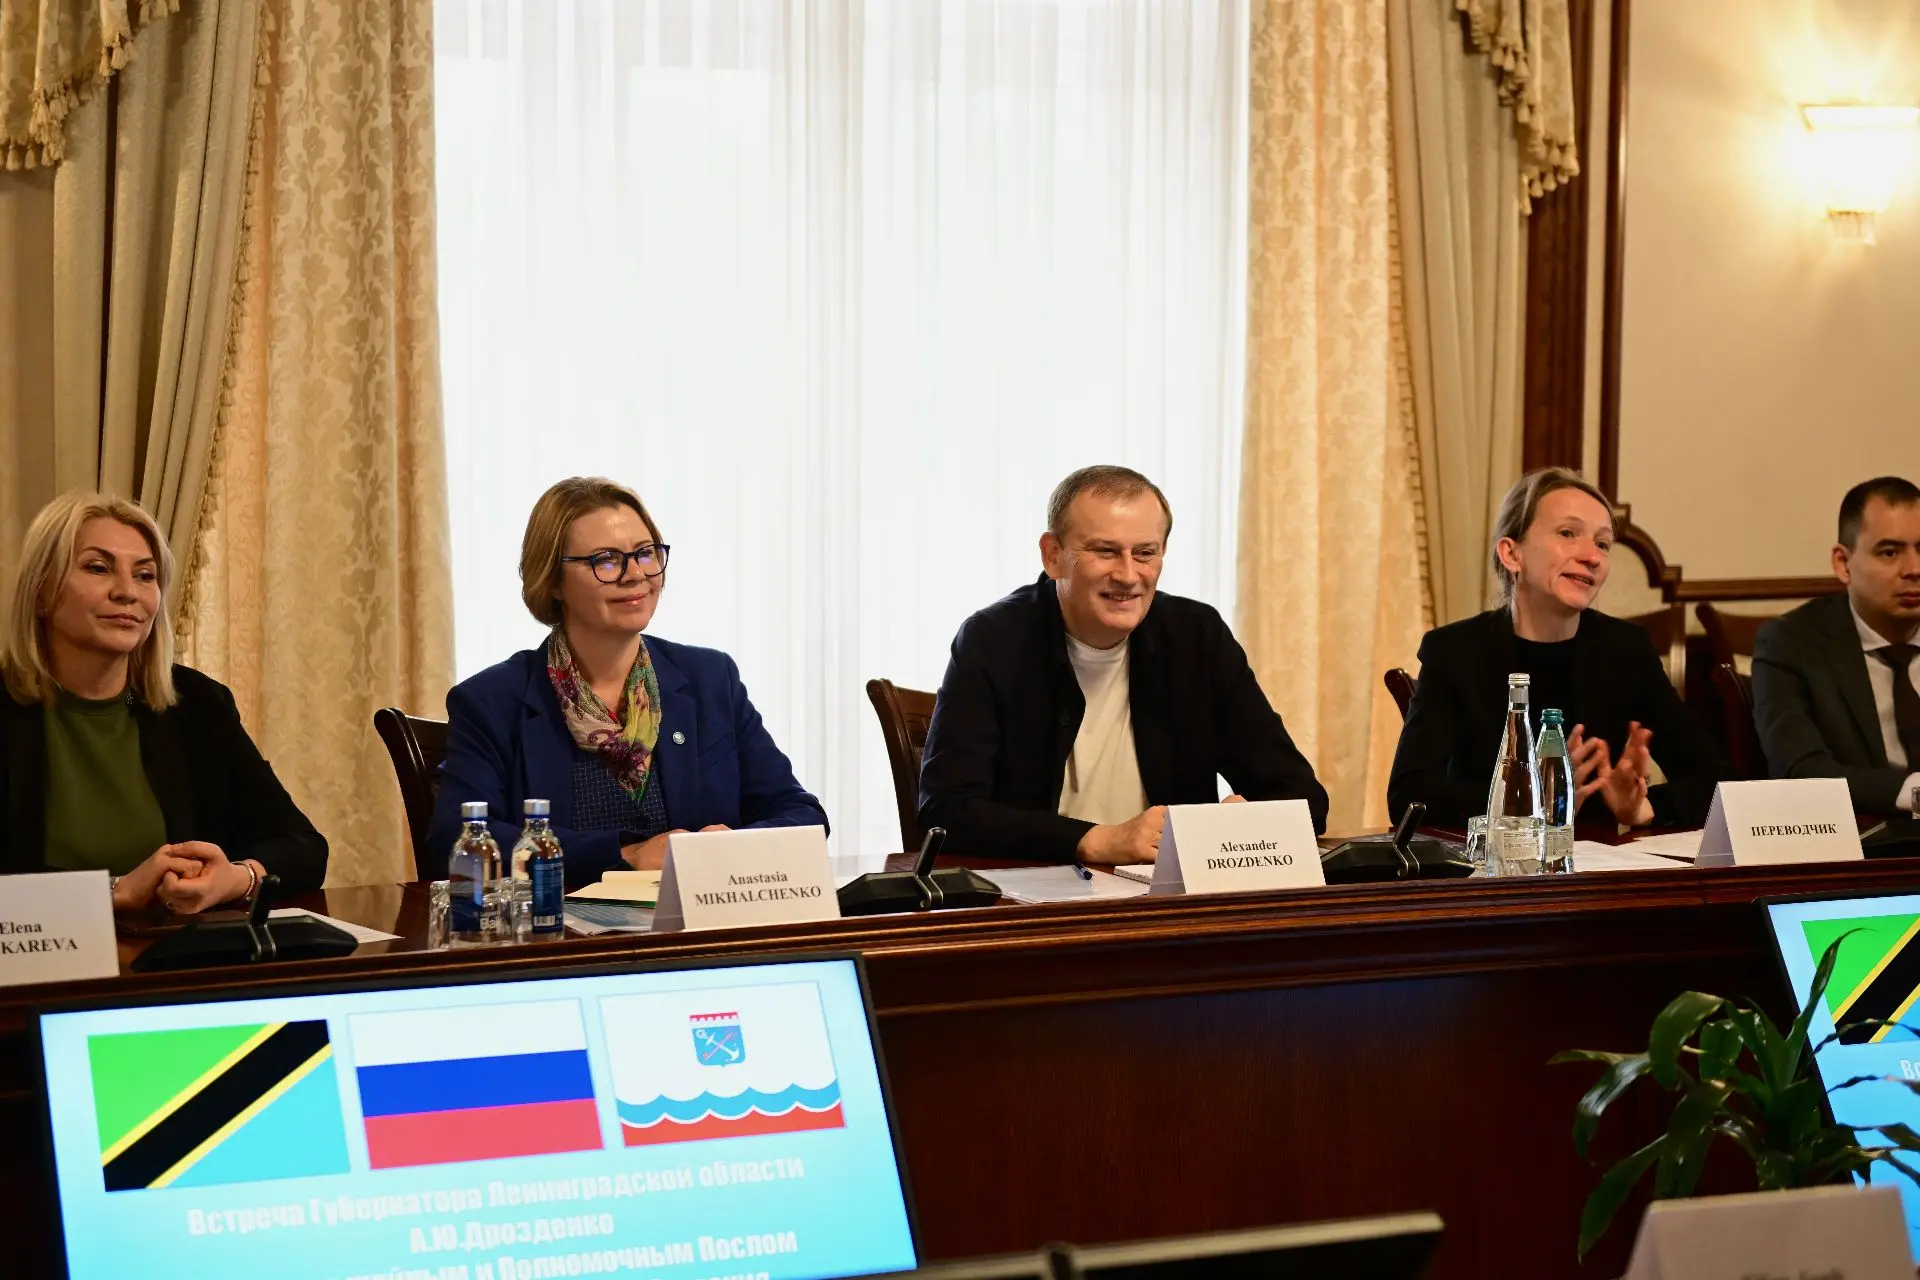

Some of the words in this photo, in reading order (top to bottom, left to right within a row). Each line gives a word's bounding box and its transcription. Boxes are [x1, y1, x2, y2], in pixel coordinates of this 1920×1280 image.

[1751, 823, 1837, 837] ПЕРЕВОДЧИК
[1219, 840, 1278, 853] Alexander
[1206, 854, 1293, 870] DROZDENKO
[727, 871, 788, 886] Anastasia
[694, 885, 822, 906] MIKHALCHENKO
[0, 921, 42, 935] Elena
[187, 1204, 306, 1235] Встреча
[309, 1187, 482, 1227] Губернатора
[488, 1165, 694, 1208] Ленинградской
[700, 1157, 805, 1188] области
[496, 1241, 695, 1280] Полномочным
[697, 1230, 799, 1263] Послом
